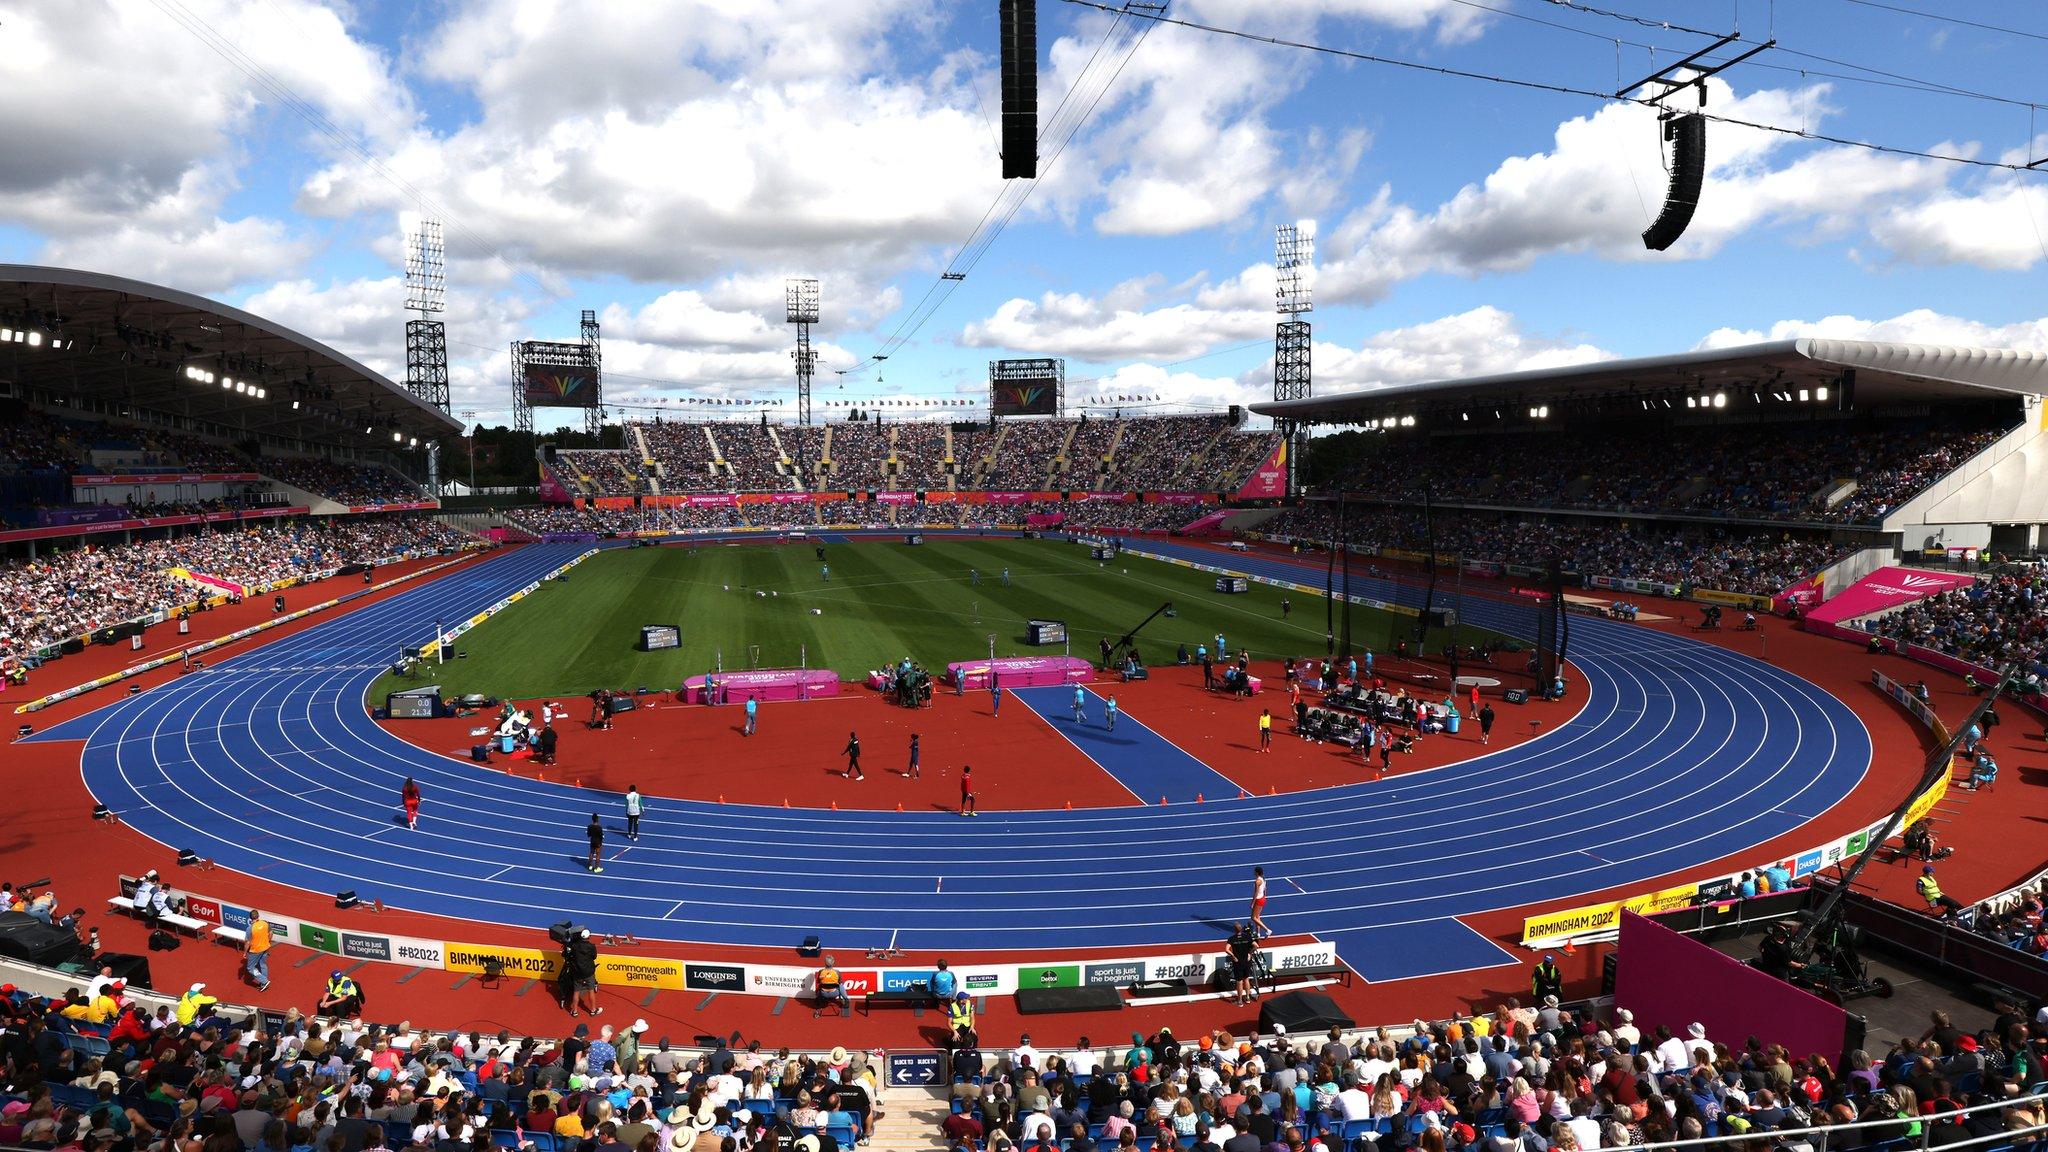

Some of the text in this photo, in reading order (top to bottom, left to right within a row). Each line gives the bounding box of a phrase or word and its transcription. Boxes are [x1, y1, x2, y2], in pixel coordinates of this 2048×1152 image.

[1798, 859, 1817, 869] CHASE
[224, 913, 247, 925] CHASE
[1530, 911, 1614, 938] BIRMINGHAM 2022
[398, 945, 440, 961] #B2022
[525, 958, 555, 973] 2022
[1282, 953, 1328, 970] #B2022
[607, 963, 677, 975] commonwealth
[1094, 968, 1114, 977] sport
[1122, 967, 1137, 976] just
[1155, 963, 1206, 979] #B2022
[626, 971, 658, 983] games
[694, 971, 737, 980] LONGINES
[1091, 972, 1140, 984] the beginning
[765, 981, 806, 989] BIRMINGHAM
